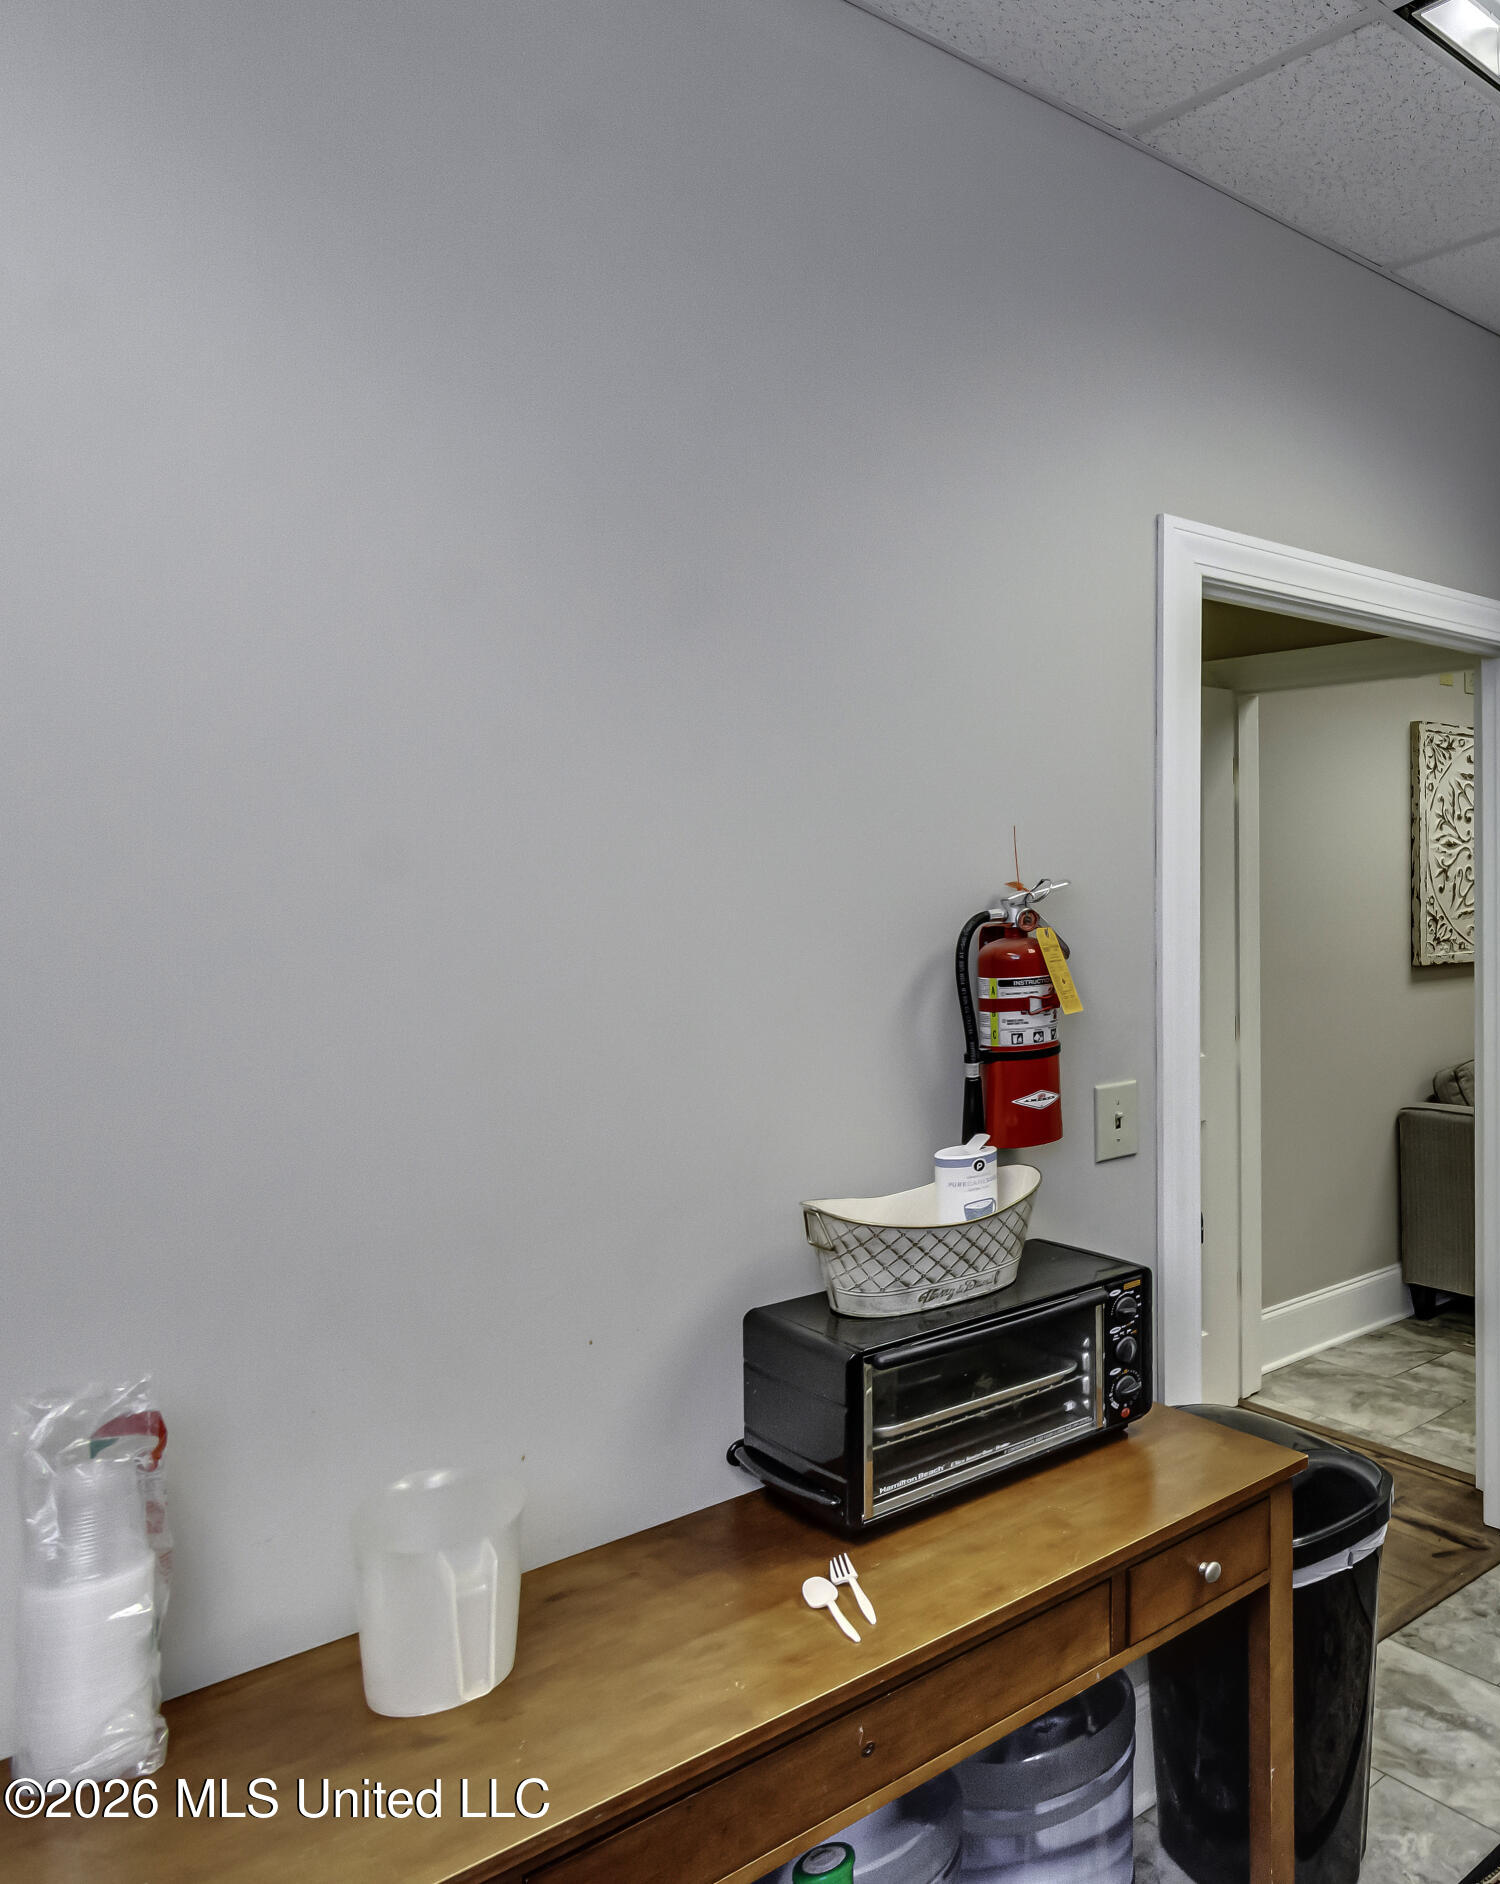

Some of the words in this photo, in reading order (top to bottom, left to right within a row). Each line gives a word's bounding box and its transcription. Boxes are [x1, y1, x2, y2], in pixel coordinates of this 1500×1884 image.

[1013, 977, 1053, 986] INSTRUCTIO
[991, 985, 996, 996] A
[992, 1030, 997, 1040] C
[879, 1476, 918, 1494] Hamilton
[918, 1464, 946, 1480] Beach
